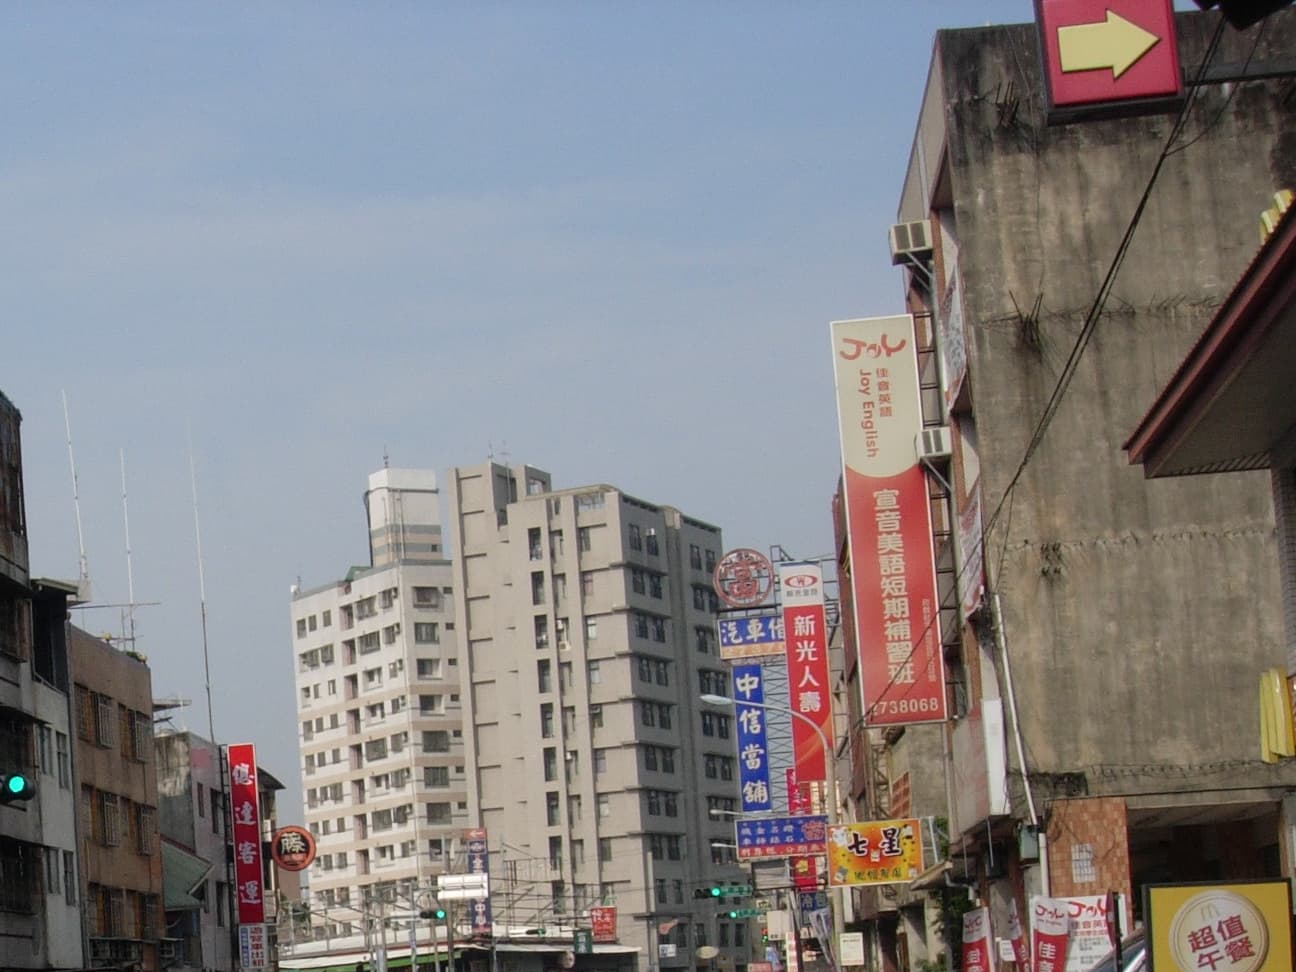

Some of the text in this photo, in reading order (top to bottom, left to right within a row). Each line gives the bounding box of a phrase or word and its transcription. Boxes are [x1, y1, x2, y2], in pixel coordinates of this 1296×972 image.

[858, 368, 880, 458] Joy English
[793, 615, 822, 712] 新光人壽
[848, 826, 902, 856] 七星
[1187, 914, 1248, 954] 超值
[1197, 936, 1256, 972] 午餐
